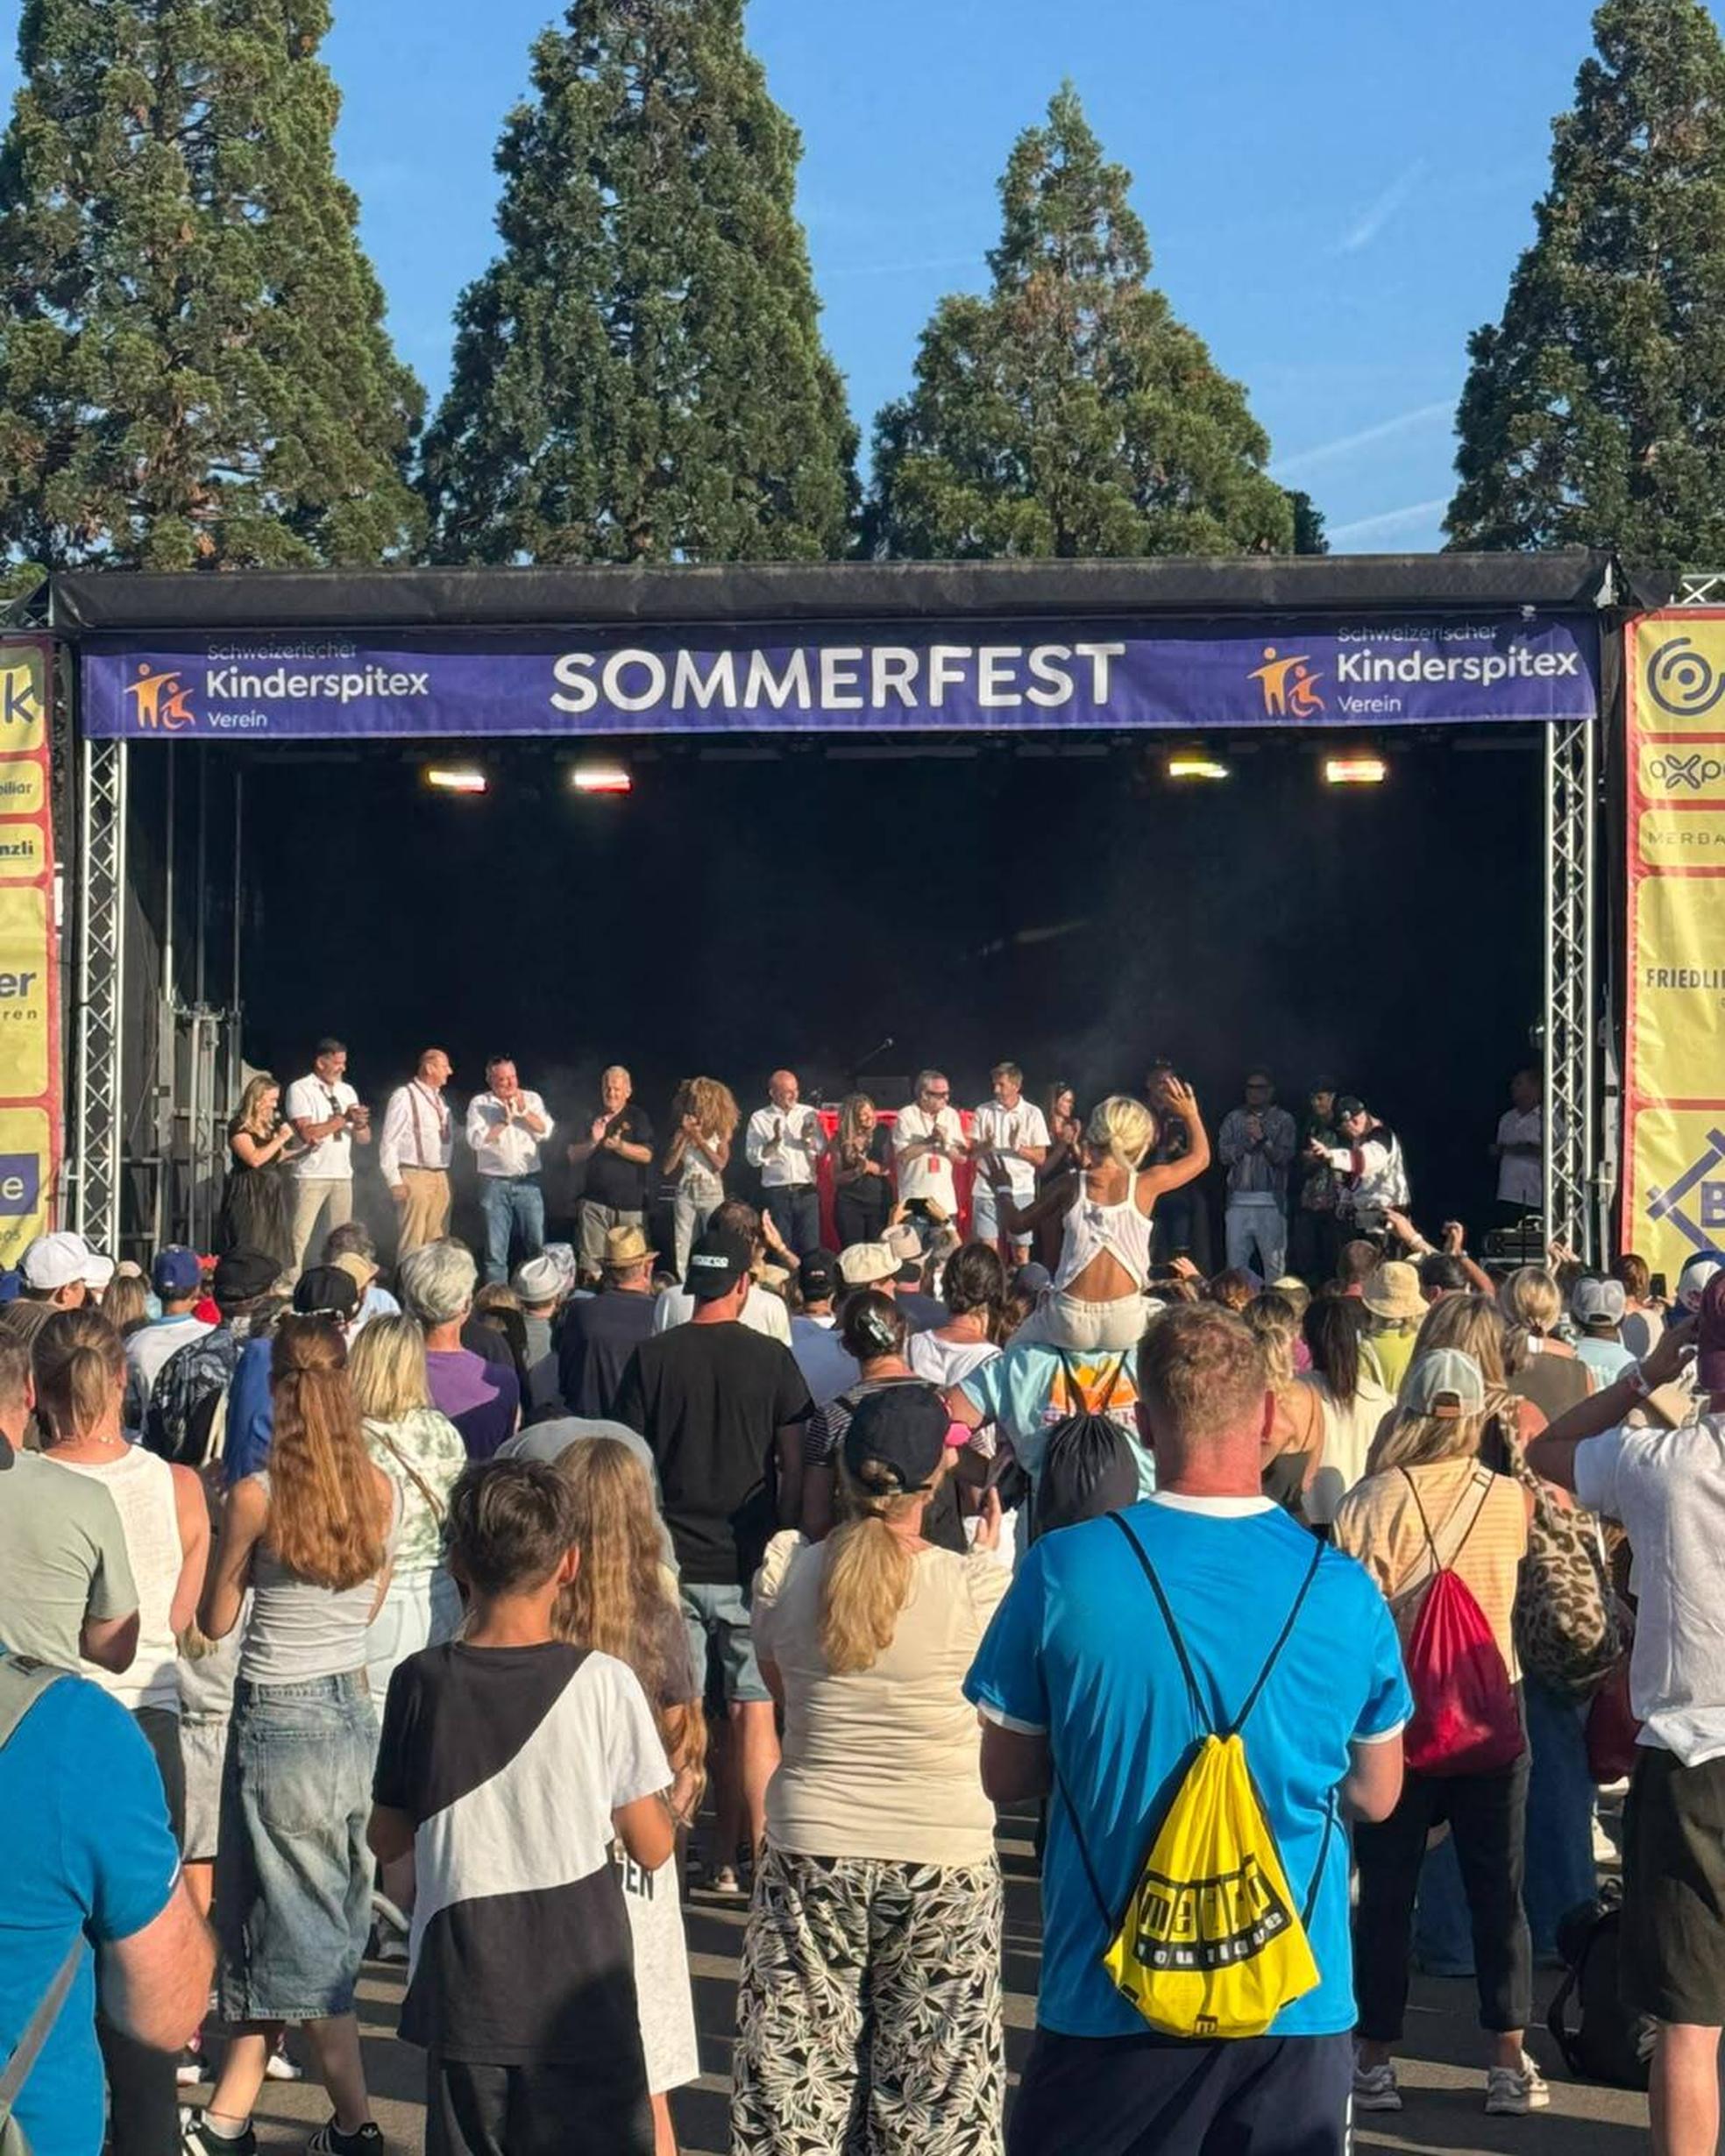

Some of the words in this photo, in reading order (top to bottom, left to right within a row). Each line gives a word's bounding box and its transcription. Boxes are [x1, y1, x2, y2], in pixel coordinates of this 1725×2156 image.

[1338, 623, 1498, 642] Schweizerischer
[207, 641, 358, 660] Schweizerischer
[1337, 645, 1579, 686] Kinderspitex
[206, 665, 429, 704] Kinderspitex
[550, 642, 1125, 712] SOMMERFEST
[1338, 695, 1402, 713] Verein
[208, 709, 267, 728] Verein
[1650, 754, 1725, 790] axp
[1646, 968, 1725, 989] FRIEDLI
